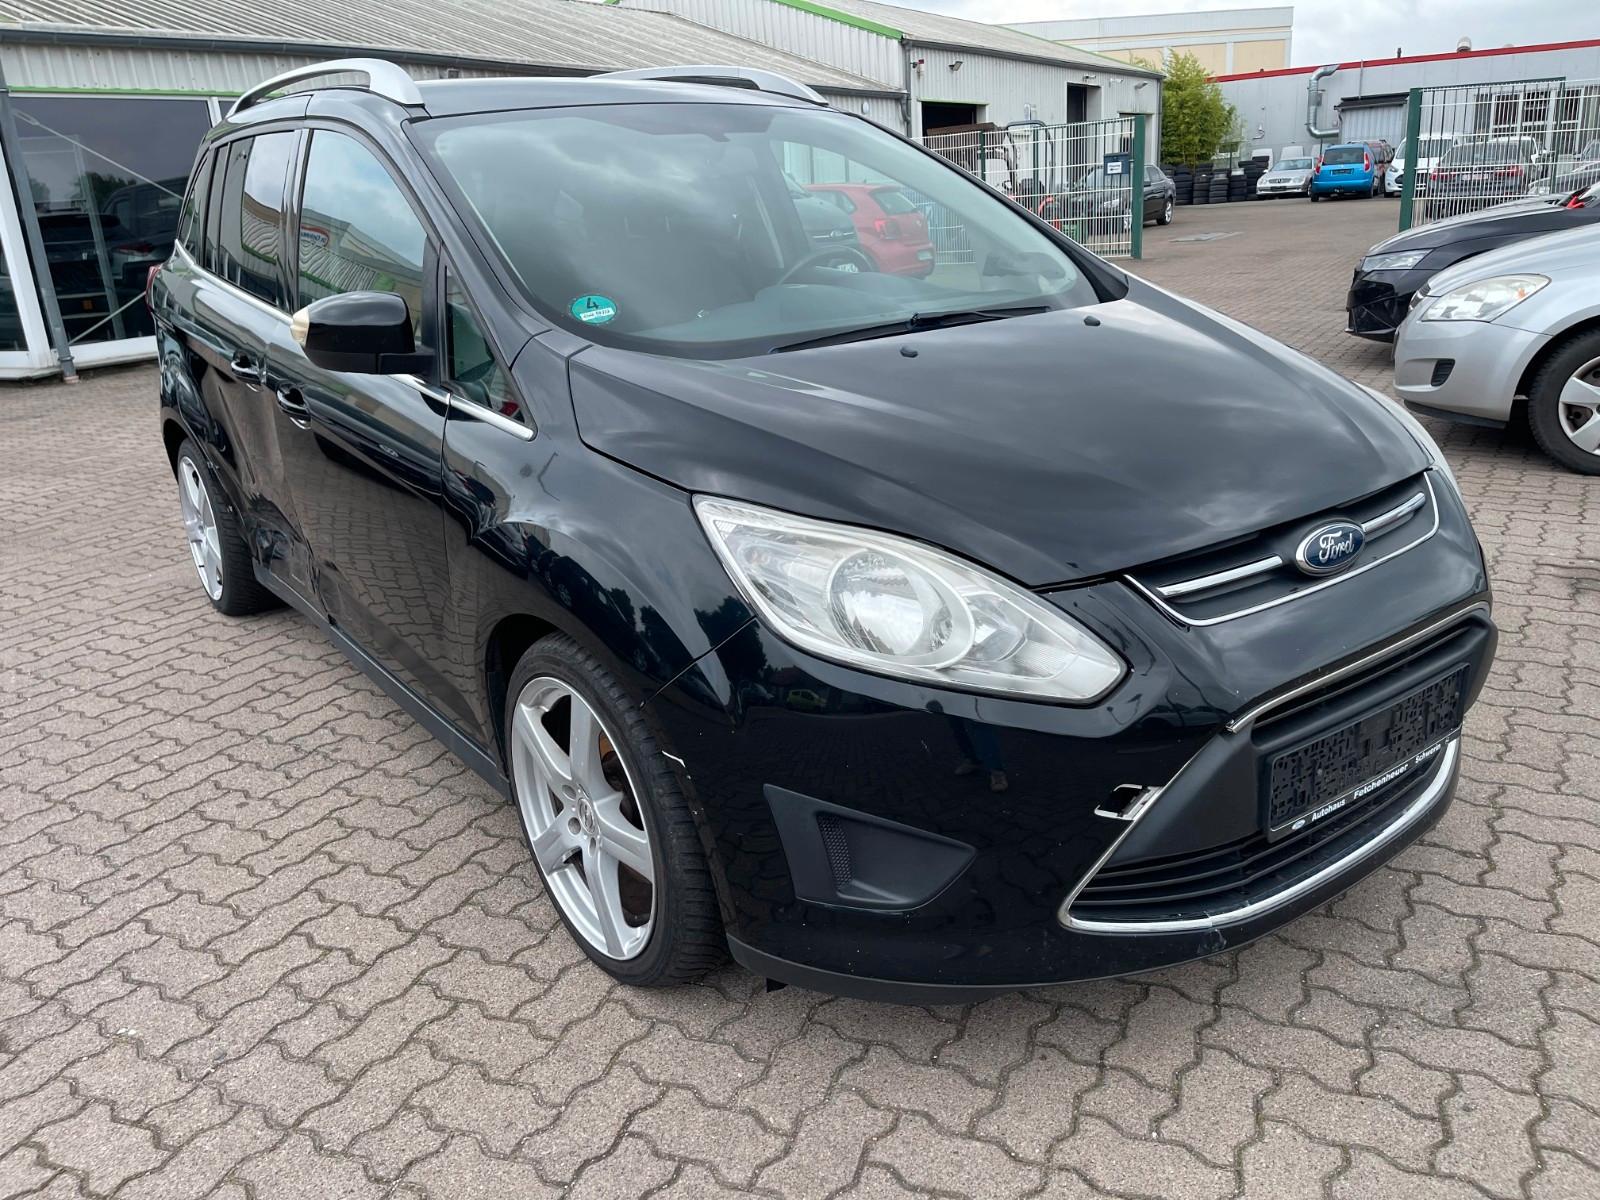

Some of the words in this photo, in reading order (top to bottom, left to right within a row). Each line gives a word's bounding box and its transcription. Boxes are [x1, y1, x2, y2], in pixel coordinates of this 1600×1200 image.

[586, 297, 599, 309] 4
[1319, 530, 1354, 563] Ford
[1311, 799, 1346, 821] Autohaus
